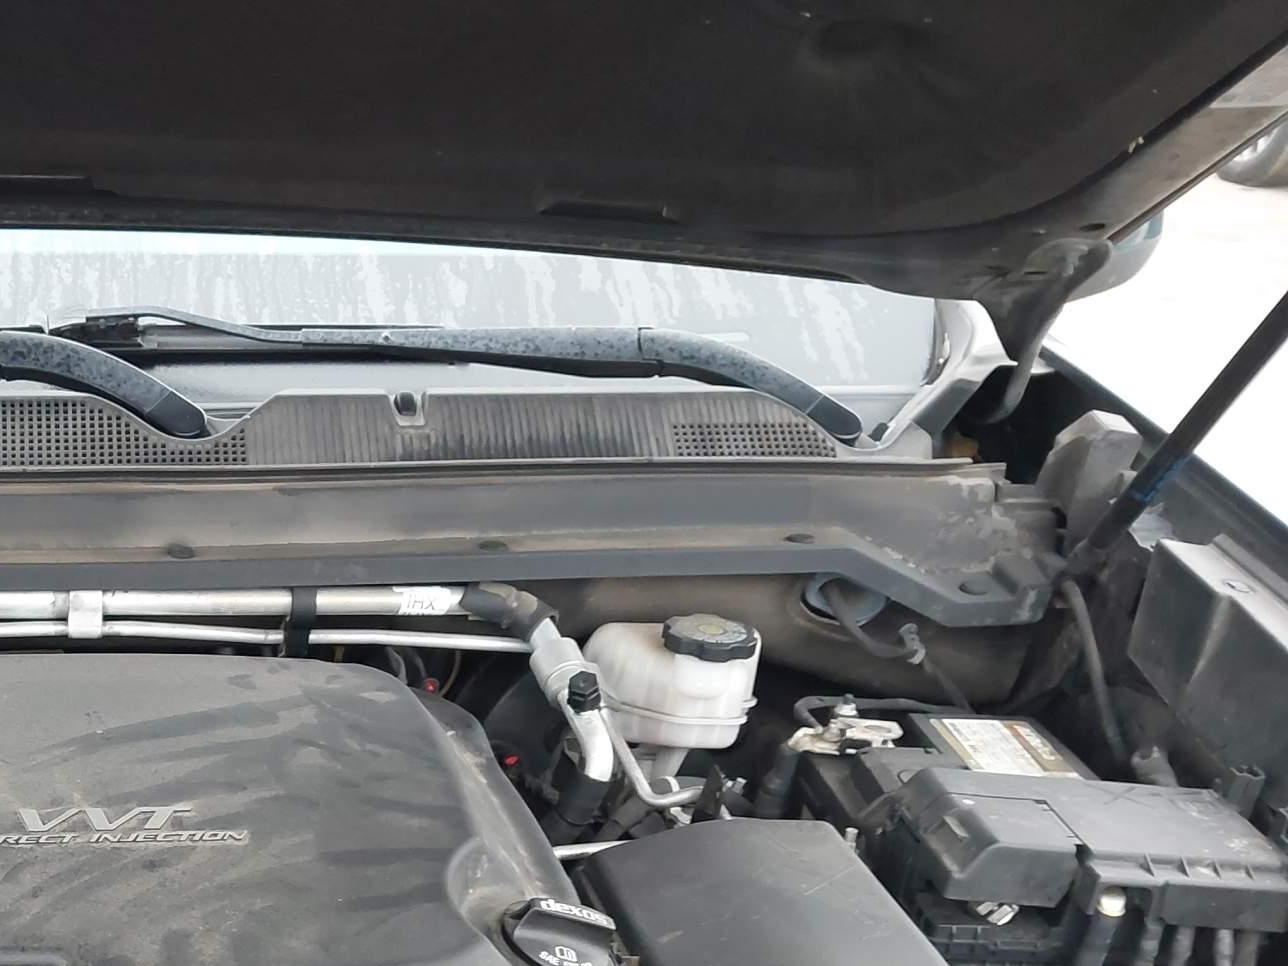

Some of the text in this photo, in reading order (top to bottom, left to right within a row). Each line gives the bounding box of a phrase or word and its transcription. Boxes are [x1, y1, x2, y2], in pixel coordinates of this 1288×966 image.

[18, 806, 192, 832] VVT
[89, 829, 248, 843] INJECTION
[540, 899, 608, 926] dexos
